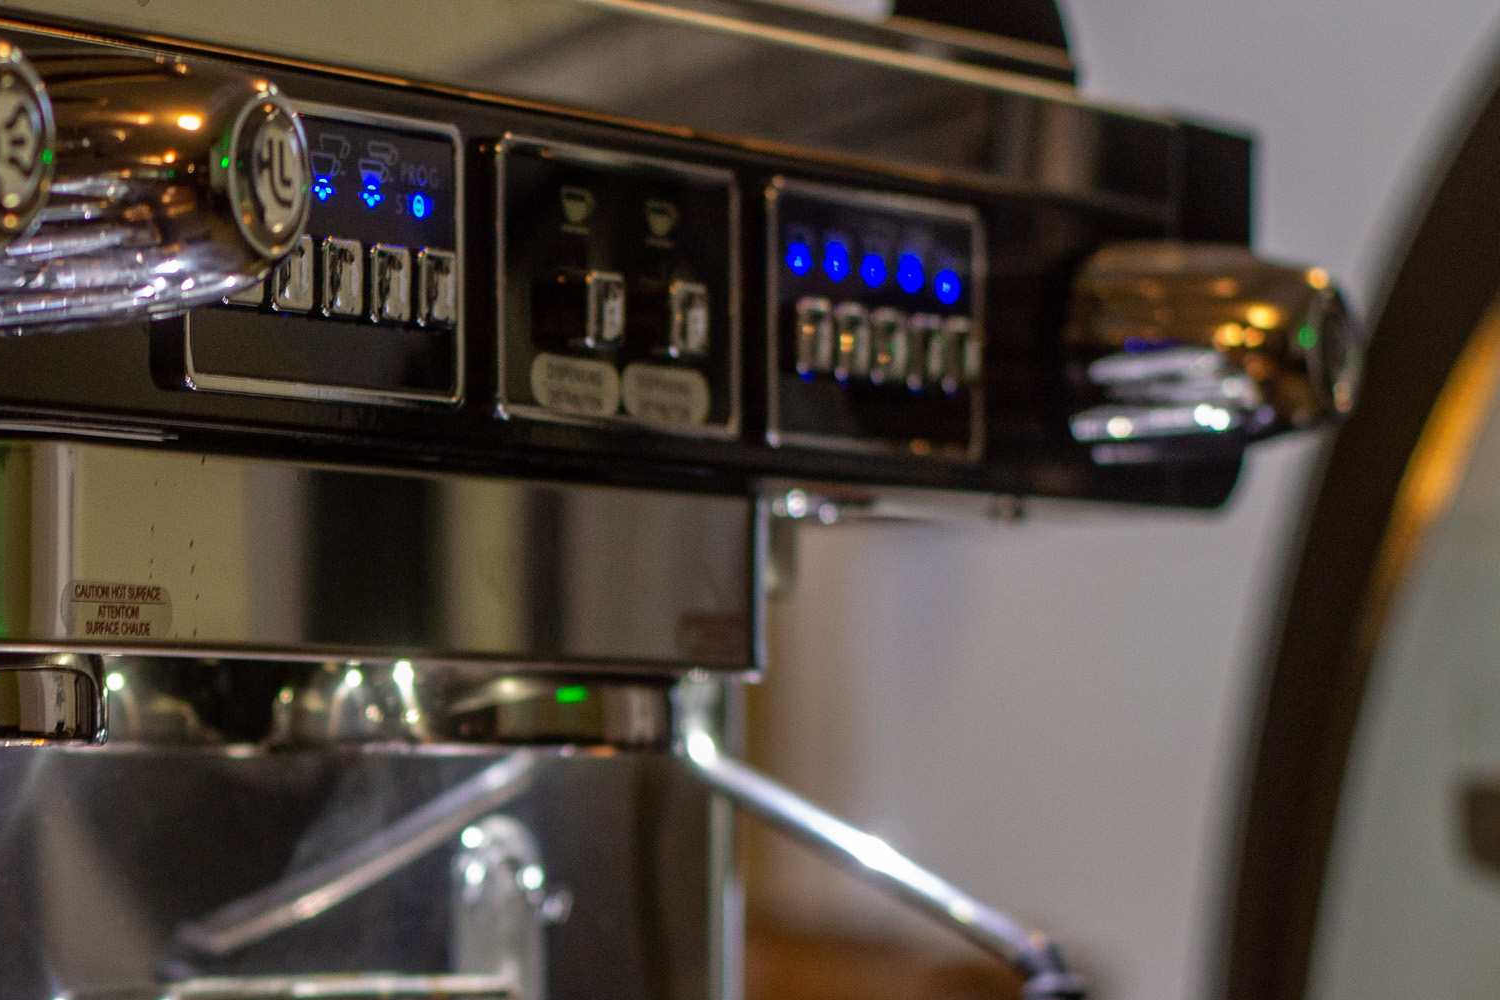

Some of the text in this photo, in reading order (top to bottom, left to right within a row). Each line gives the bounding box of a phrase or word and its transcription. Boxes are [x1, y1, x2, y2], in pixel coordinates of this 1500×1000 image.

[111, 586, 127, 600] HOT
[128, 586, 162, 601] SURFACE
[85, 621, 151, 637] SURFACE CHAUDE
